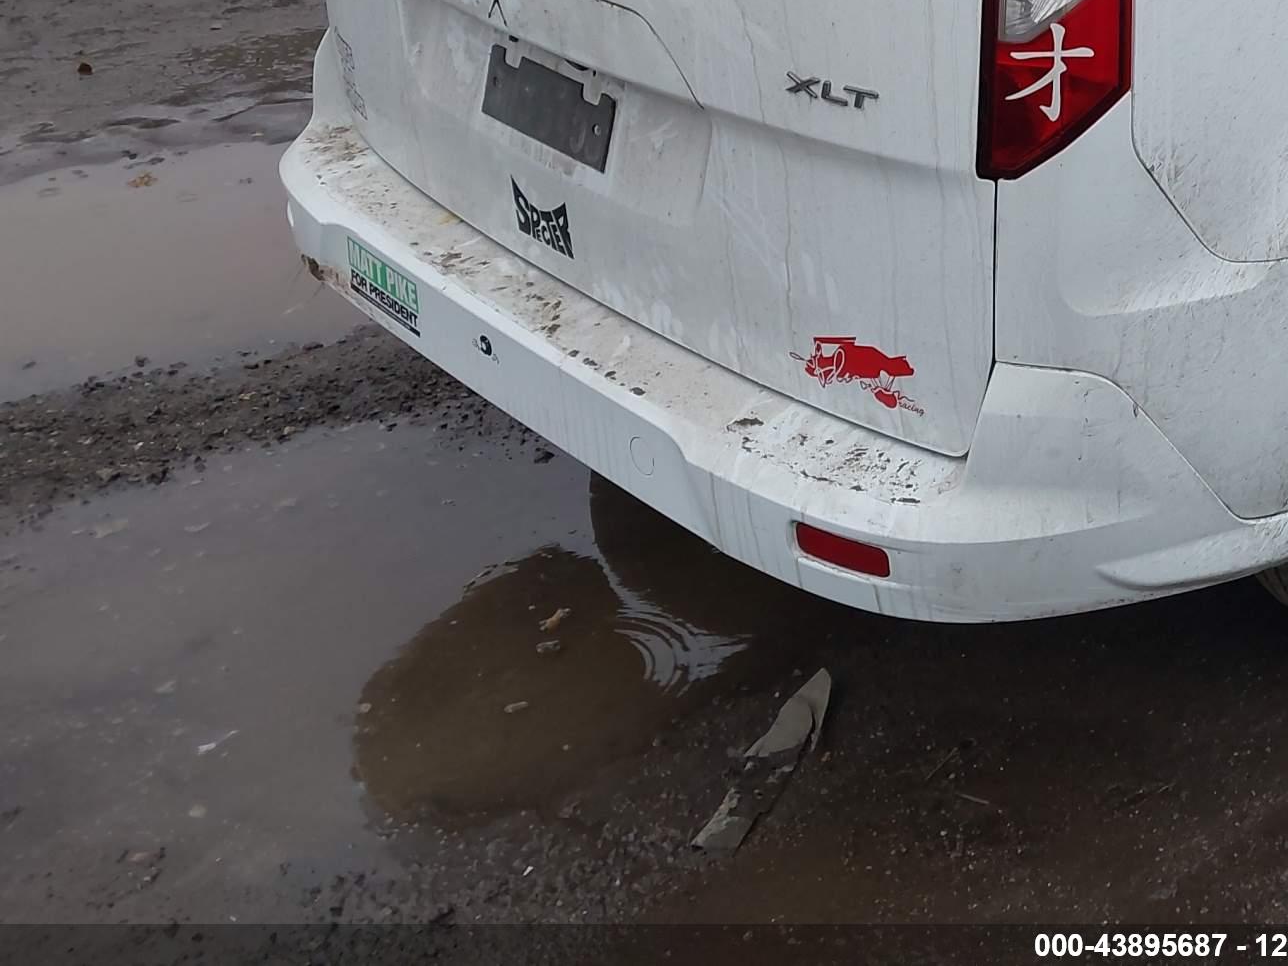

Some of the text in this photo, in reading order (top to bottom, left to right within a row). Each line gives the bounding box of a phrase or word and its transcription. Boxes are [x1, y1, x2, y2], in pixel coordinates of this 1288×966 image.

[784, 71, 880, 109] XLT
[509, 173, 576, 260] SPECTER
[349, 239, 417, 309] MATT PIKE
[351, 269, 418, 327] FOR PRESIDENT
